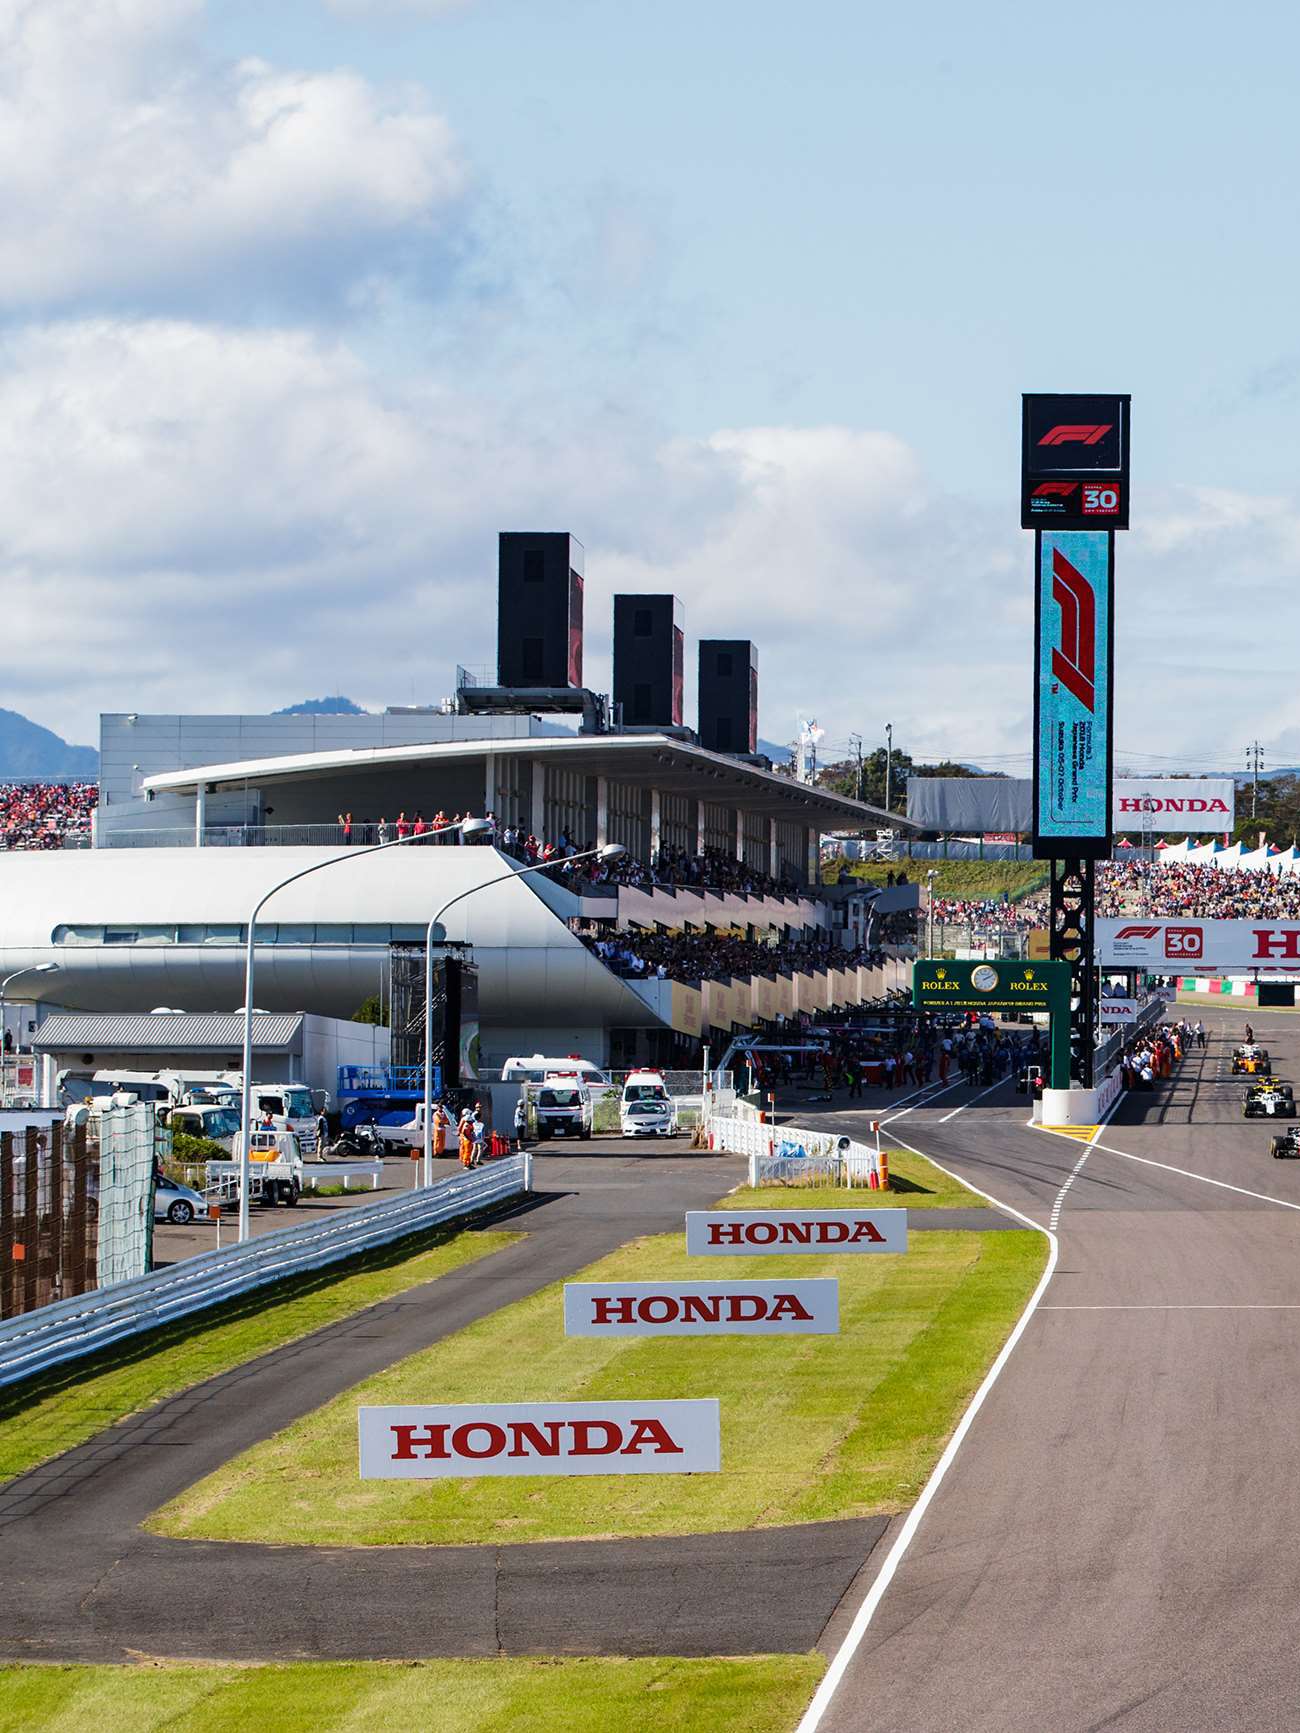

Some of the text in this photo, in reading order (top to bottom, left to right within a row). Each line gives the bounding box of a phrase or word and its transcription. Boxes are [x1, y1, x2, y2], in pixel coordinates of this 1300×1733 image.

[1084, 490, 1118, 509] 30
[1078, 743, 1086, 770] Honda
[1118, 798, 1230, 813] HONDA
[1167, 933, 1201, 952] 30
[922, 981, 960, 990] ROLEX
[1010, 982, 1048, 991] ROLEX
[1101, 1006, 1132, 1014] NDA
[708, 1221, 886, 1245] HONDA
[592, 1295, 814, 1325] HONDA
[388, 1419, 686, 1461] HONDA
